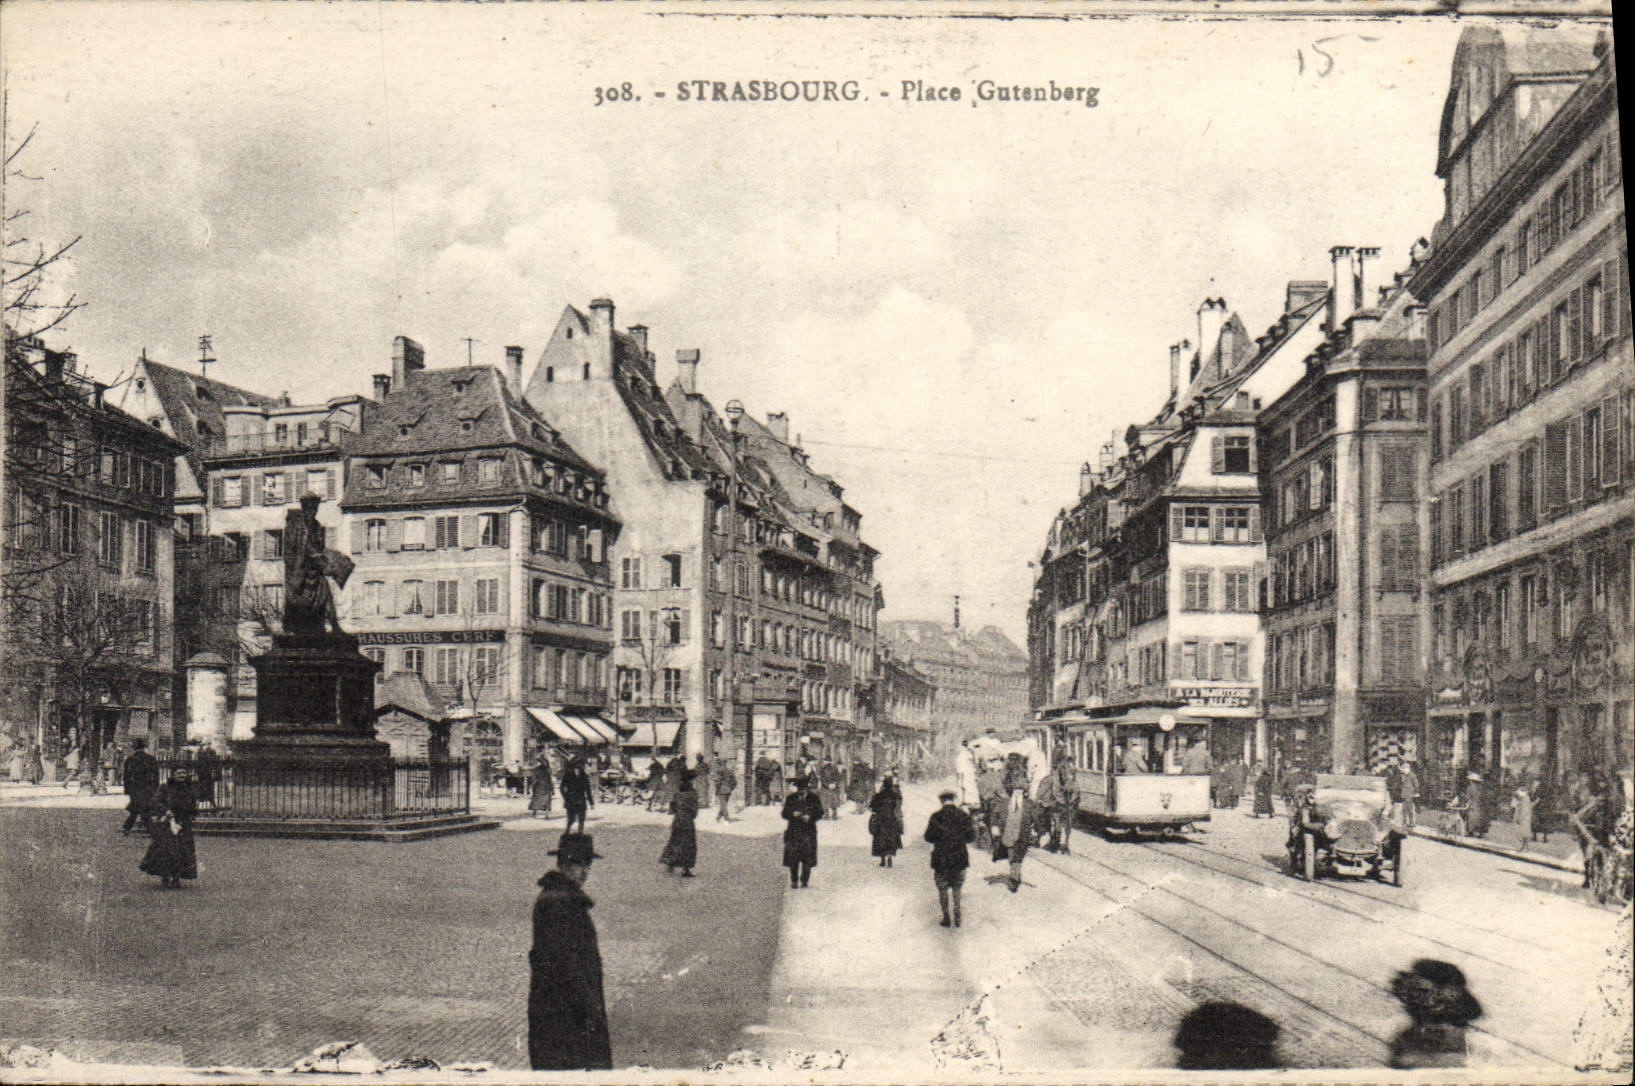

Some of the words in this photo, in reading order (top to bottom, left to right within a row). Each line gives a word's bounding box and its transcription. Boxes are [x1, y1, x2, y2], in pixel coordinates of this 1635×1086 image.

[358, 631, 443, 645] HAUSSURES
[451, 630, 497, 643] CERF
[1175, 687, 1184, 698] A
[1185, 687, 1198, 698] LA
